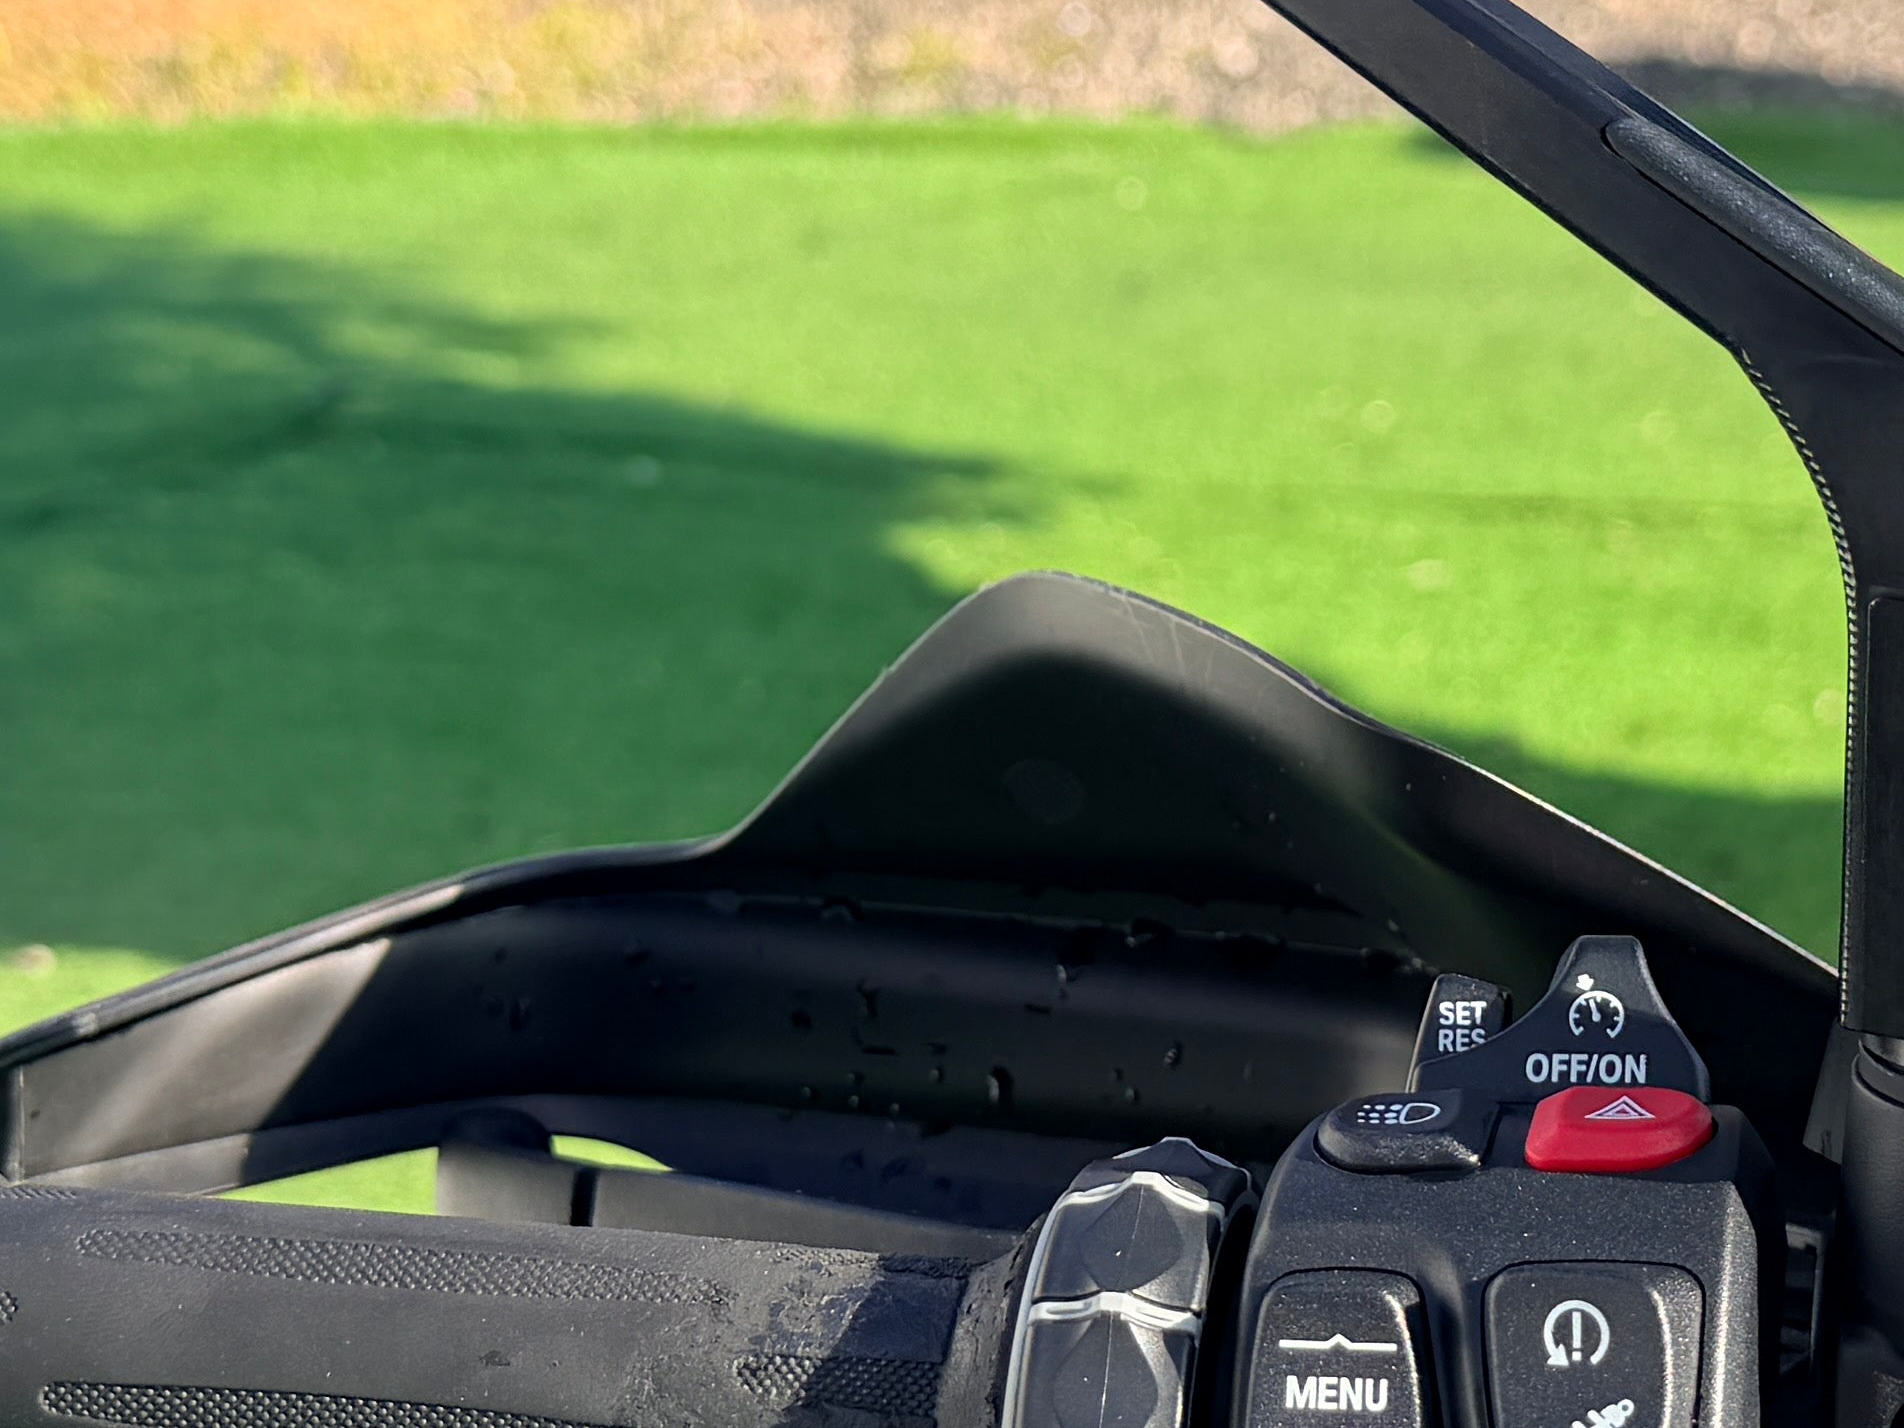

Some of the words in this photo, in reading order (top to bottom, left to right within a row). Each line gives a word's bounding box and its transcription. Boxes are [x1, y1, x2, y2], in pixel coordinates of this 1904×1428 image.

[1438, 1000, 1488, 1026] SET
[1438, 1028, 1486, 1052] RES
[1525, 1052, 1648, 1085] OFF/ON
[1284, 1374, 1389, 1413] MENU
